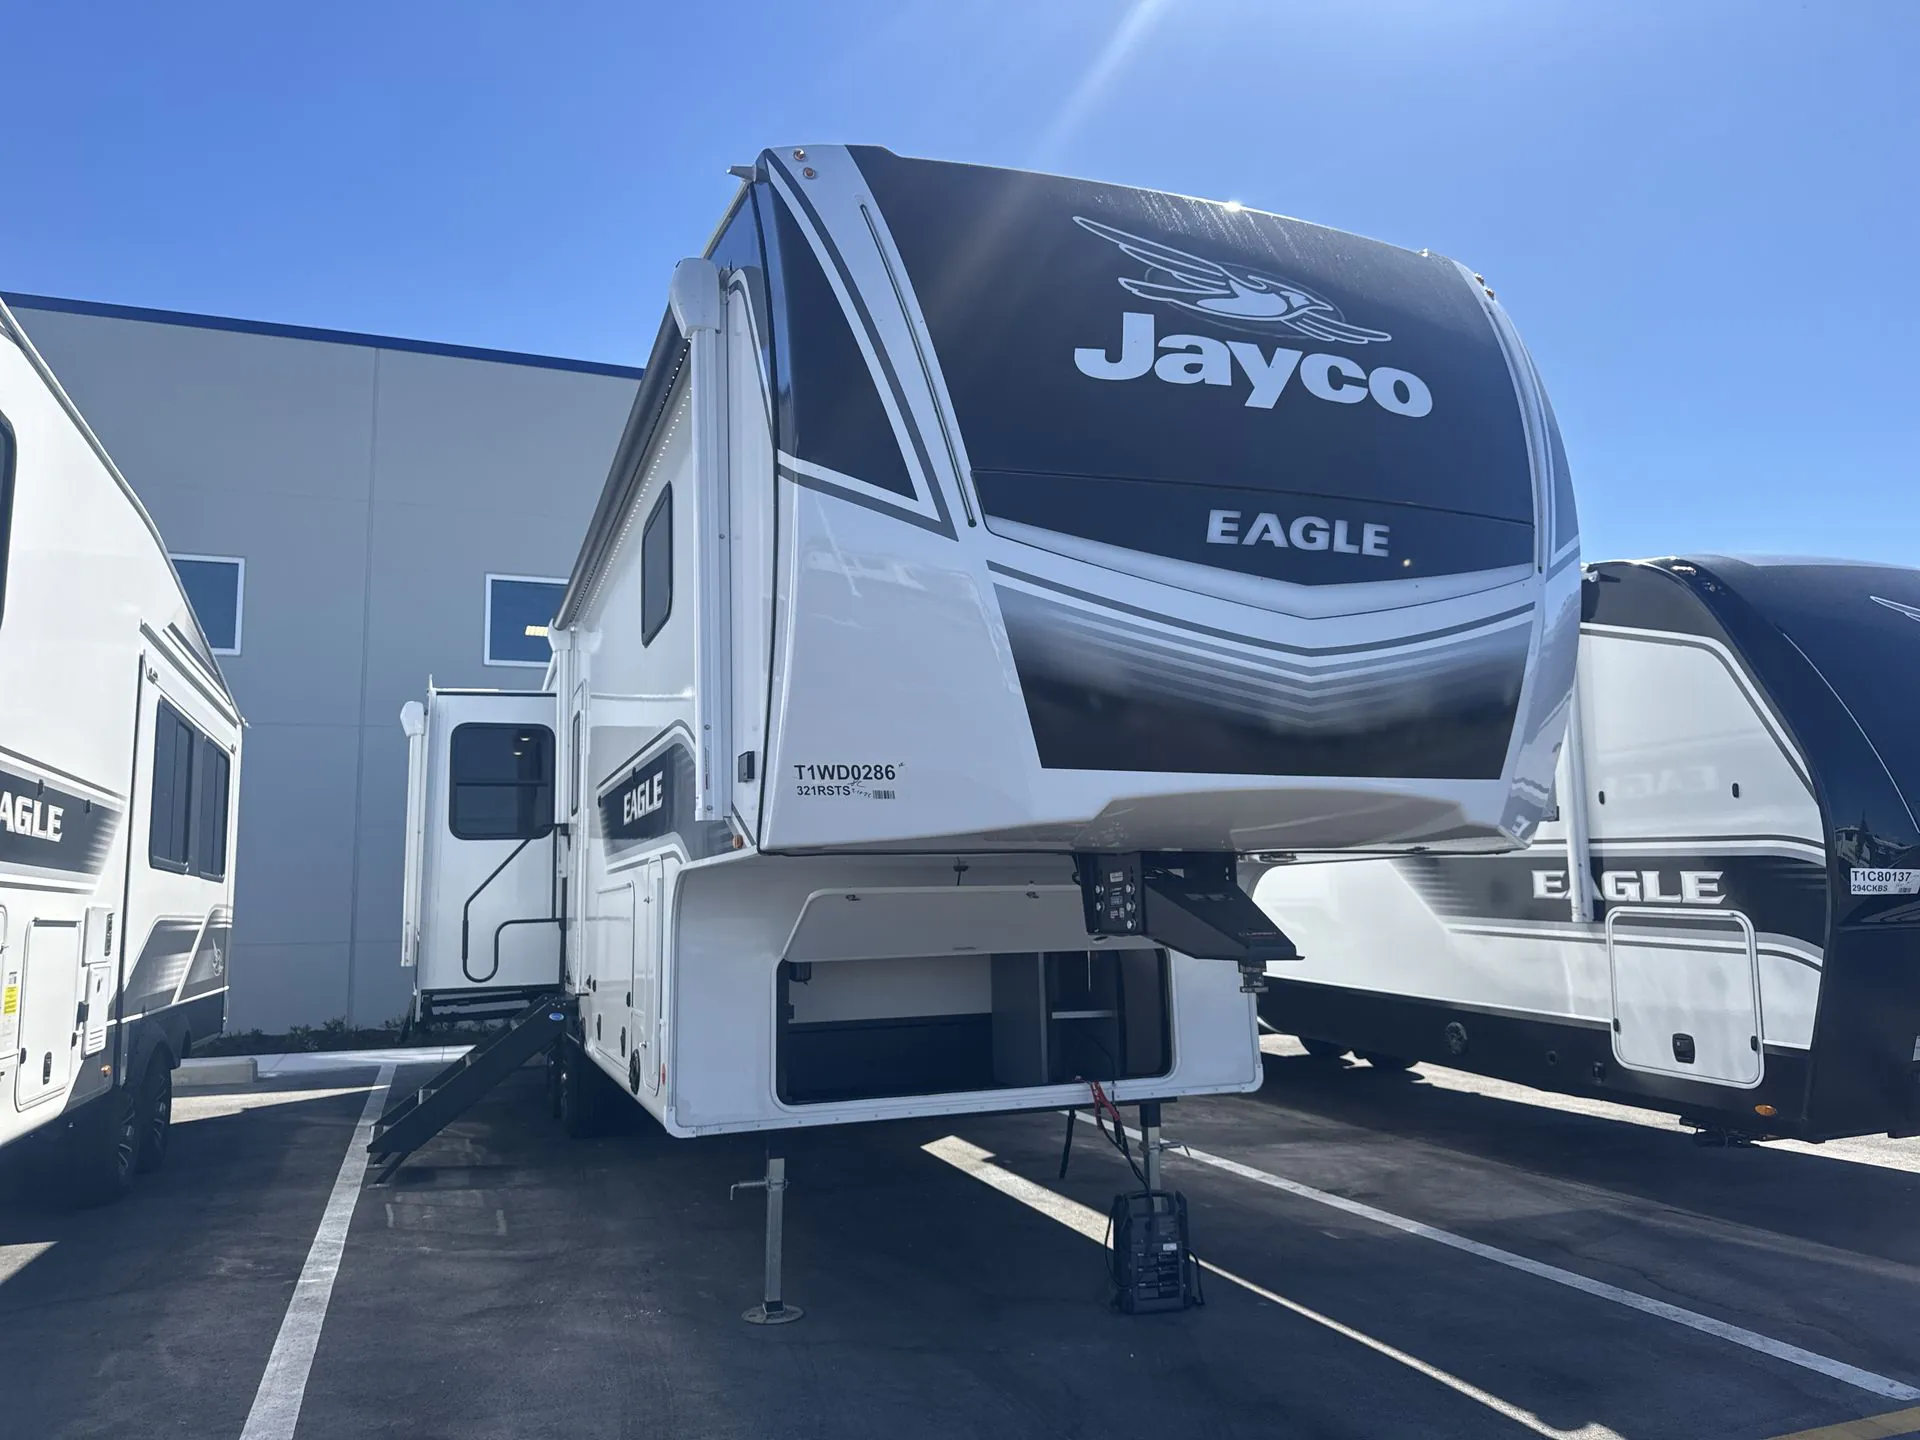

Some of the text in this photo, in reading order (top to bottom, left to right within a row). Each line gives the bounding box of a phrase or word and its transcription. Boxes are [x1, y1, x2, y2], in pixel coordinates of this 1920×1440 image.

[1074, 312, 1433, 418] Jayco
[1206, 509, 1390, 557] EAGLE
[794, 764, 896, 780] T1WD0286
[623, 770, 664, 826] EAGLE
[796, 785, 851, 796] 321RSTS
[1852, 870, 1912, 882] T1C80137
[1852, 884, 1888, 892] 294CKBS
